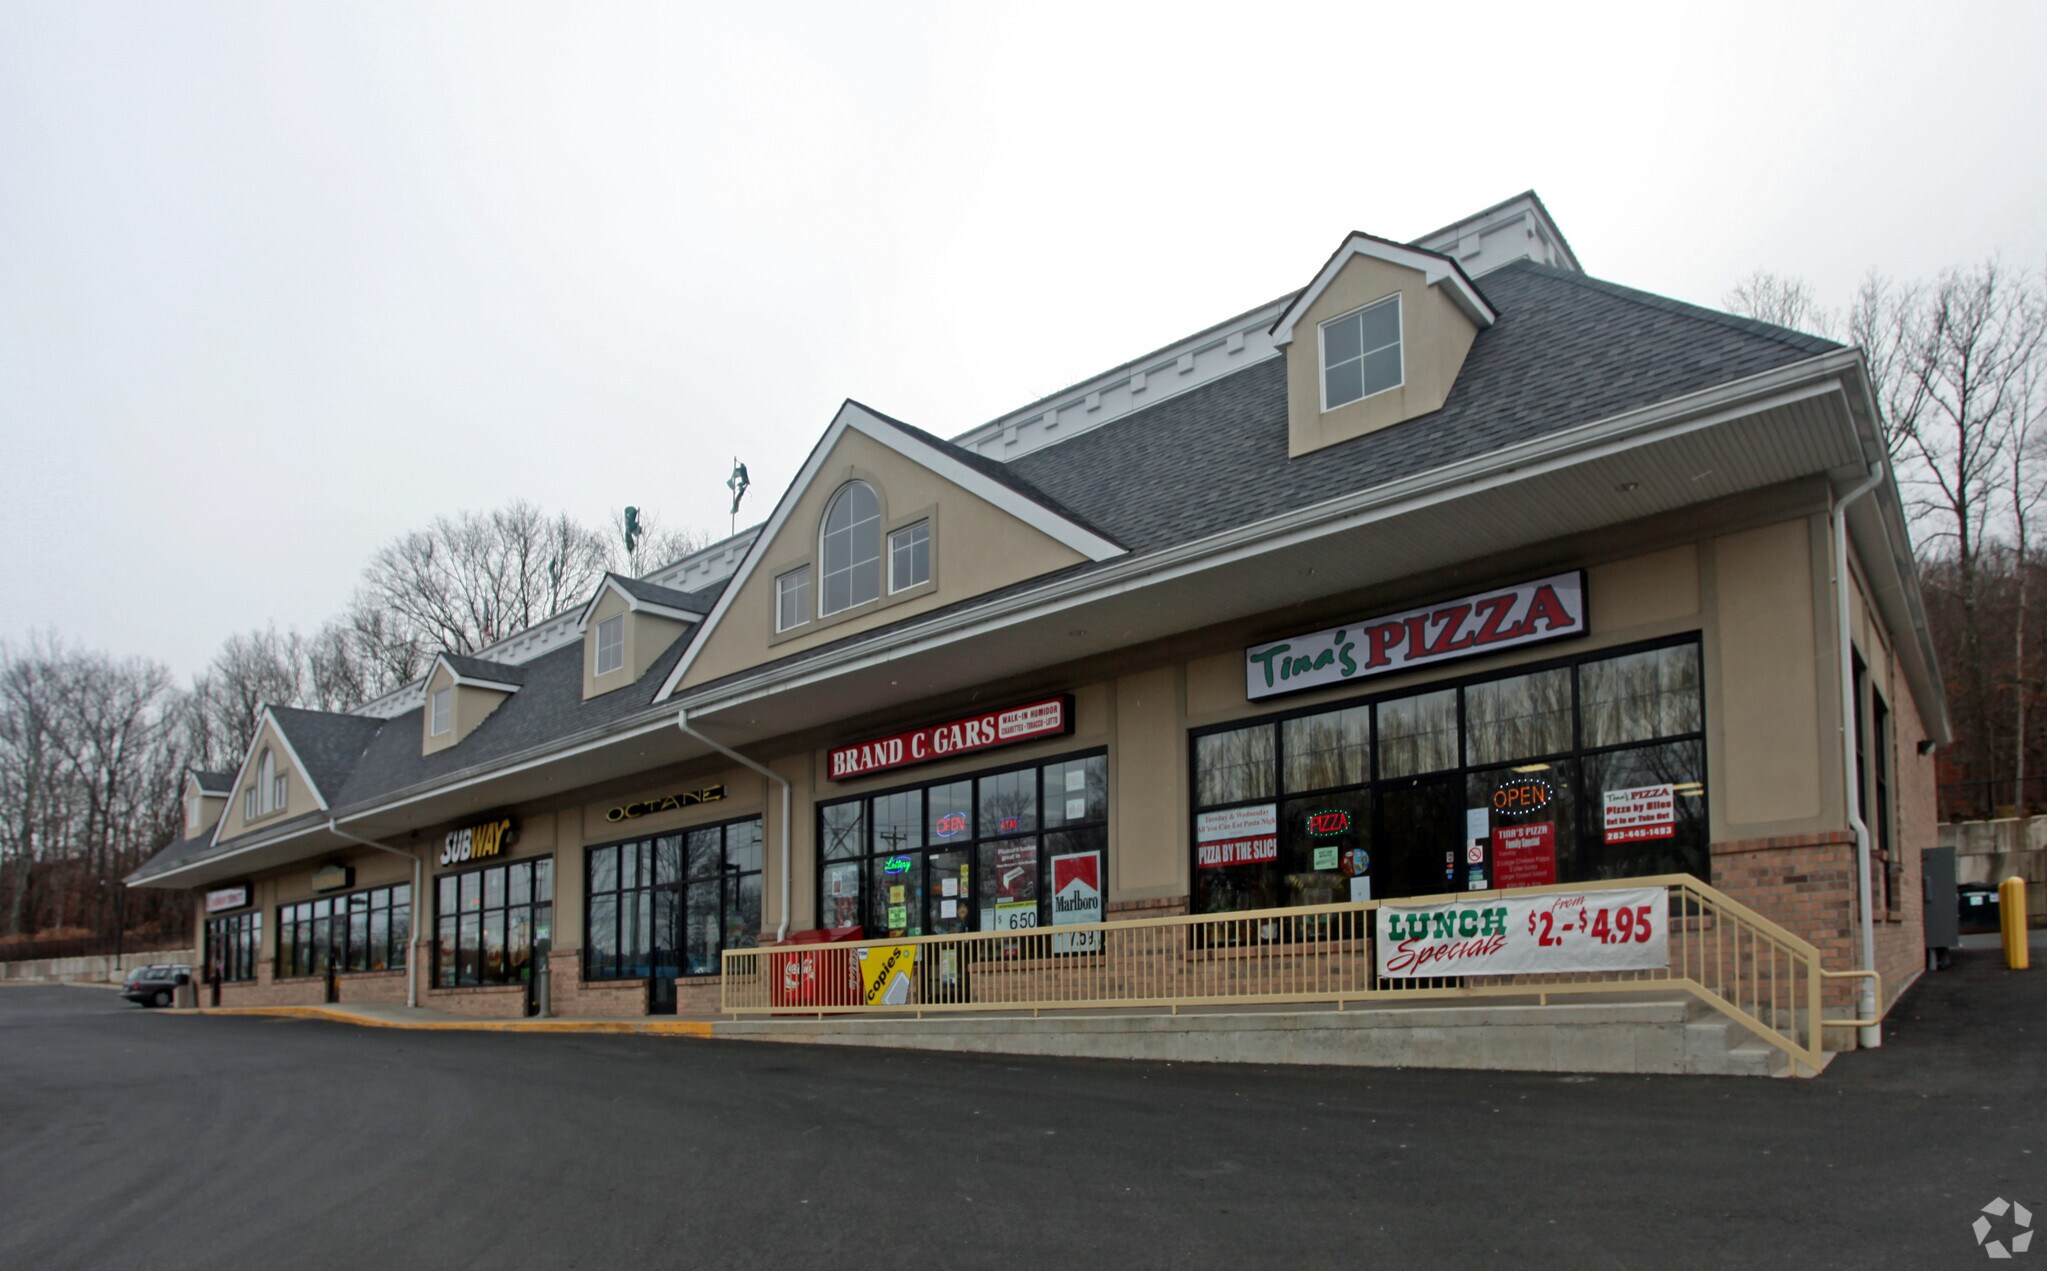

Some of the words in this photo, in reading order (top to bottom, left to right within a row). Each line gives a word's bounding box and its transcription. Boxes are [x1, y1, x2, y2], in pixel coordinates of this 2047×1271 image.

[1250, 629, 1357, 687] Tina's
[1364, 583, 1576, 669] PIZZA
[1002, 711, 1028, 724] WALK-IN
[1030, 705, 1058, 718] HUMIDOR
[832, 738, 903, 776] BRAND
[605, 784, 722, 822] OCTANE
[1494, 784, 1546, 808] OPEN
[1631, 788, 1670, 800] PIZZA
[1236, 809, 1269, 818] Wednesday
[1606, 806, 1631, 815] Pizza
[1633, 804, 1644, 813] by
[936, 816, 966, 833] OPEN
[1000, 818, 1017, 831] ATM
[1310, 812, 1348, 832] PIZZA
[1525, 825, 1548, 836] PIZZA
[440, 817, 510, 866] SUBWAY
[1198, 845, 1221, 865] PIZZA
[1222, 843, 1234, 862] BY
[1235, 841, 1252, 861] THE
[884, 856, 911, 873] Lottery
[1055, 890, 1098, 912] Marlboro
[1551, 895, 1585, 912] from
[1388, 907, 1508, 941] LUNCH
[1387, 931, 1508, 975] Specials
[867, 947, 901, 1001] copies
